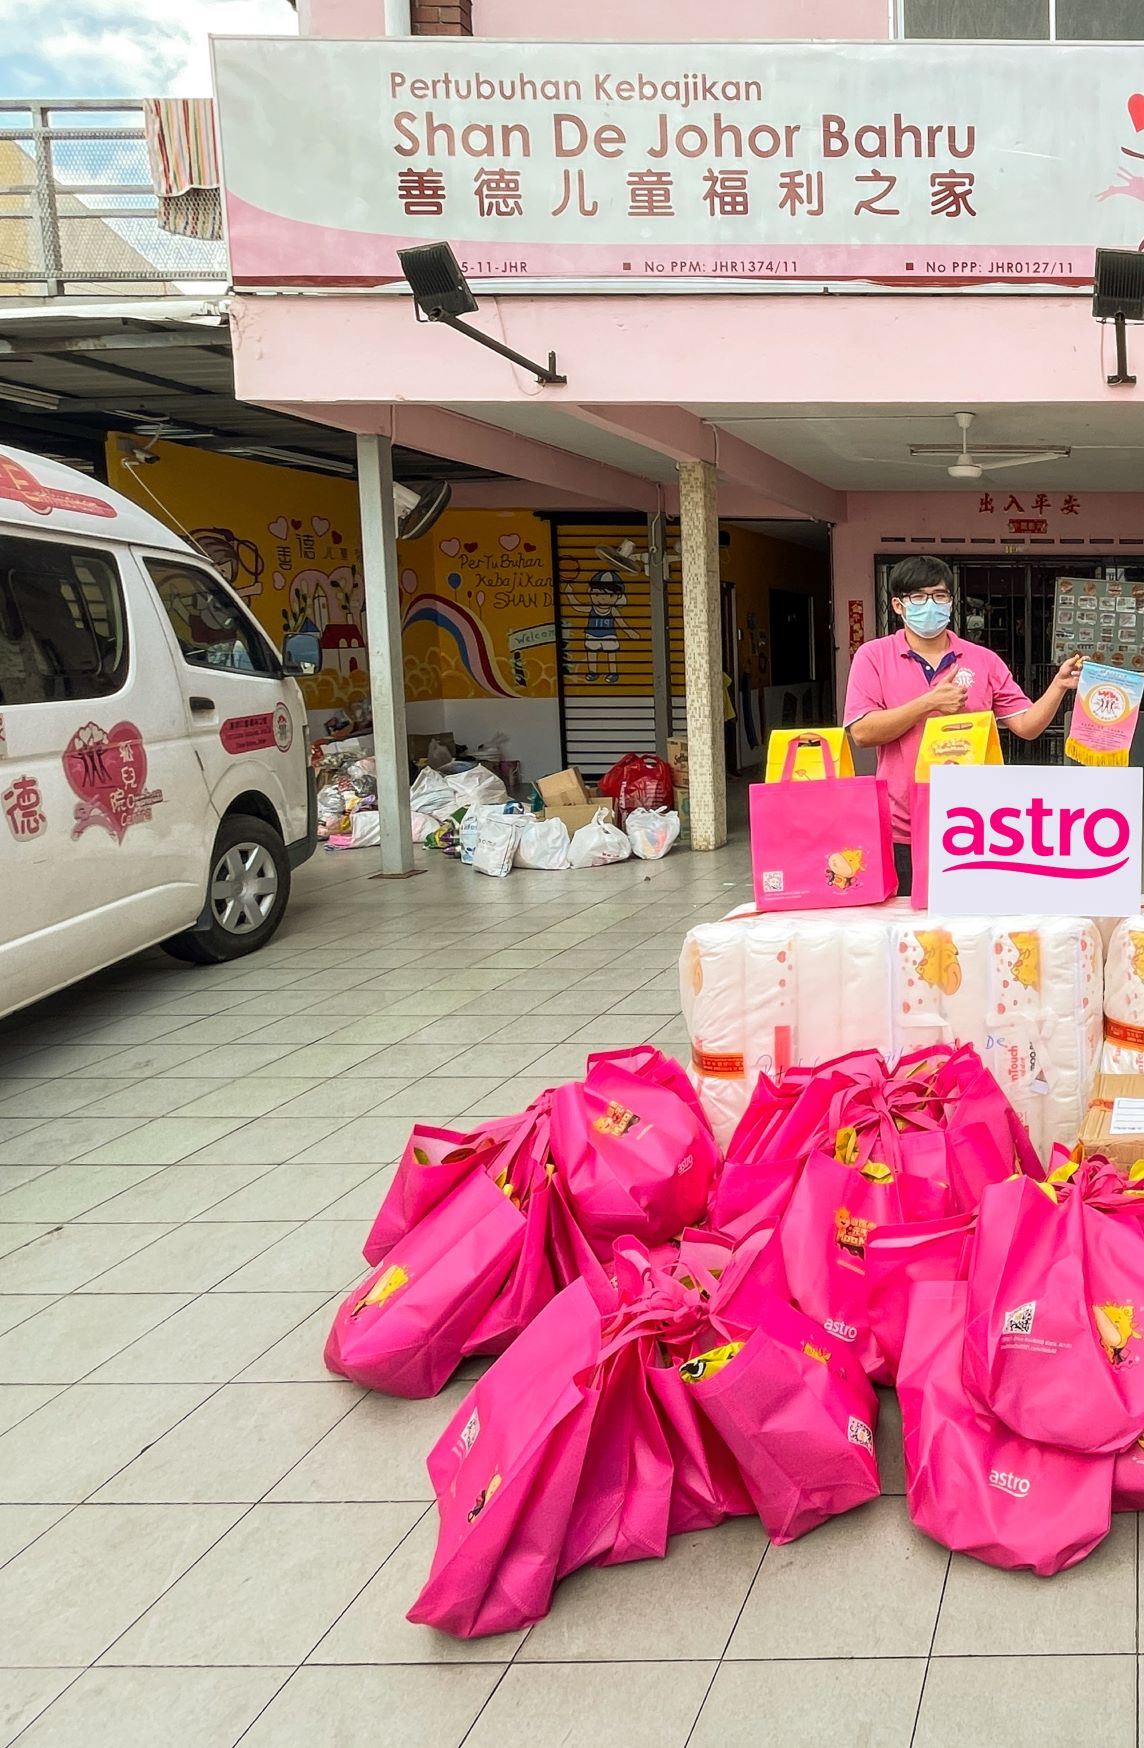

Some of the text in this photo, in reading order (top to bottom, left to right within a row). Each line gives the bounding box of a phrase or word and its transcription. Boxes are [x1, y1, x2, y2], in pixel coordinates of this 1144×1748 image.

[390, 72, 762, 108] Pertubuhan Kebajikan
[393, 111, 976, 160] Shan De Johor Bahru
[397, 167, 976, 218] 善德儿童福利之家
[460, 261, 528, 274] 5-11-JHR
[644, 260, 798, 274] No PPM: JHR1374/11
[926, 261, 1073, 275] No PPP: JHR0127/11
[979, 492, 1081, 516] 出入平安
[4, 776, 46, 835] 德
[942, 798, 1130, 858] astro
[1008, 1045, 1018, 1082] nTouch
[824, 1318, 857, 1341] astro
[989, 1470, 1031, 1497] astro
